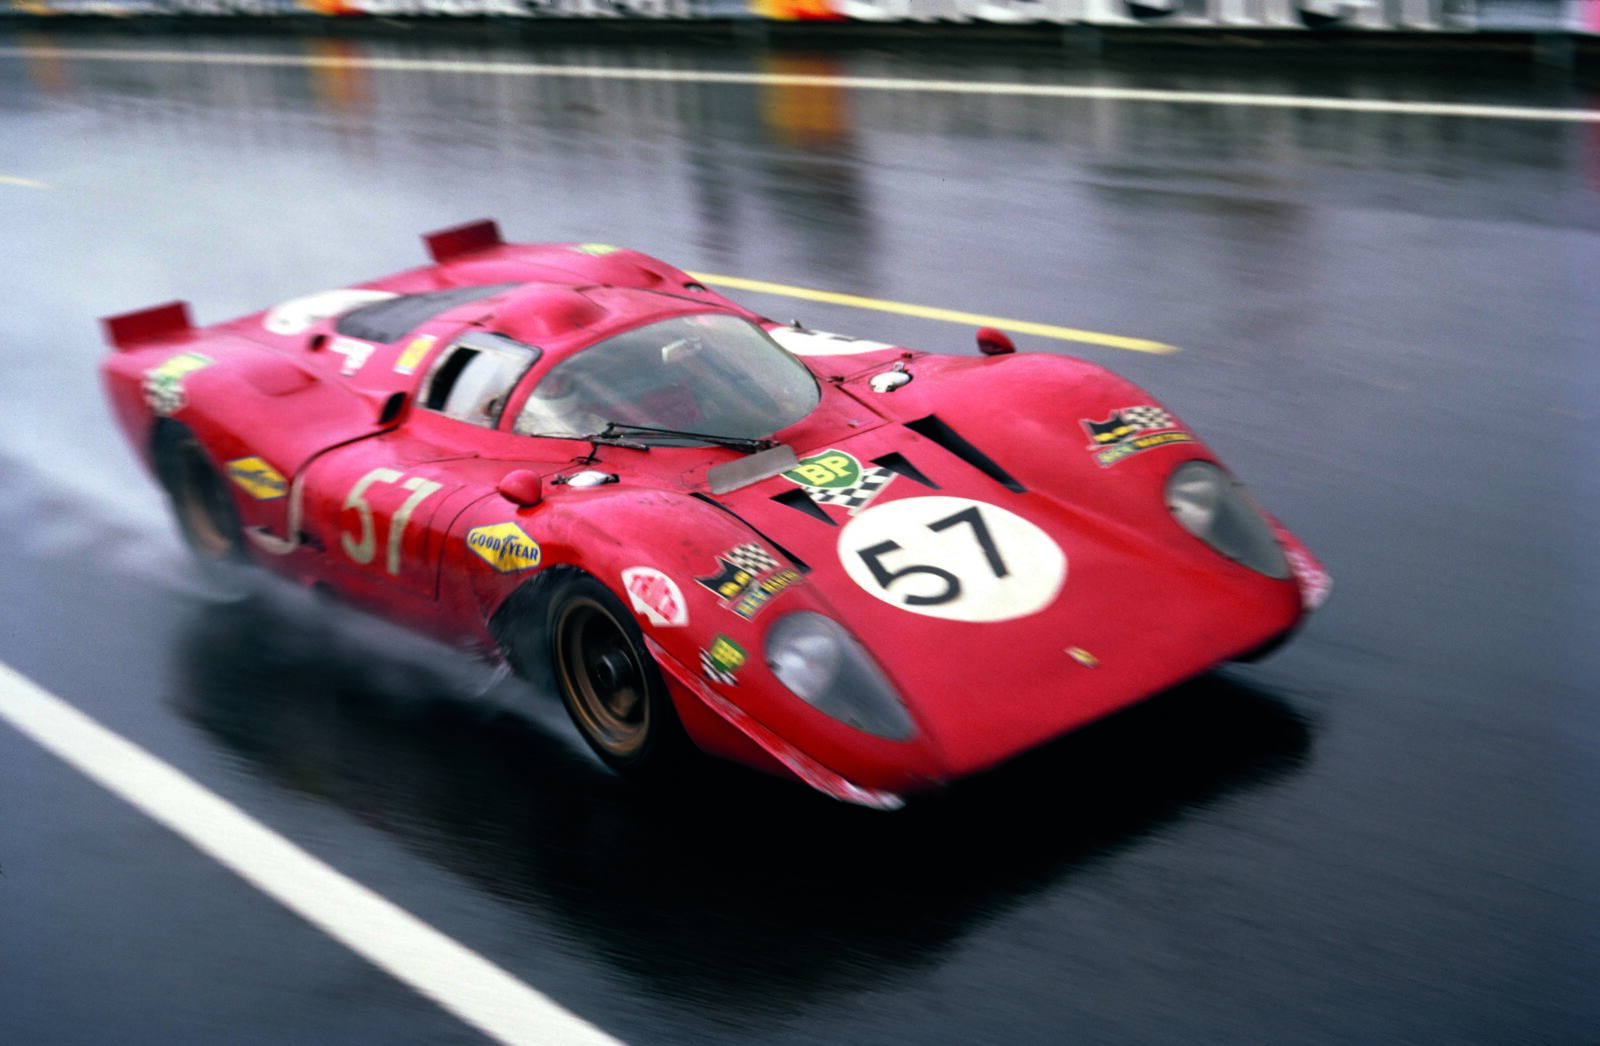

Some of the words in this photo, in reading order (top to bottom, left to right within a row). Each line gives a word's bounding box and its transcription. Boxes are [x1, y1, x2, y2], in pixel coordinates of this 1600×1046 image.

[342, 467, 444, 575] 57
[792, 456, 852, 486] BP
[856, 506, 1009, 606] 57
